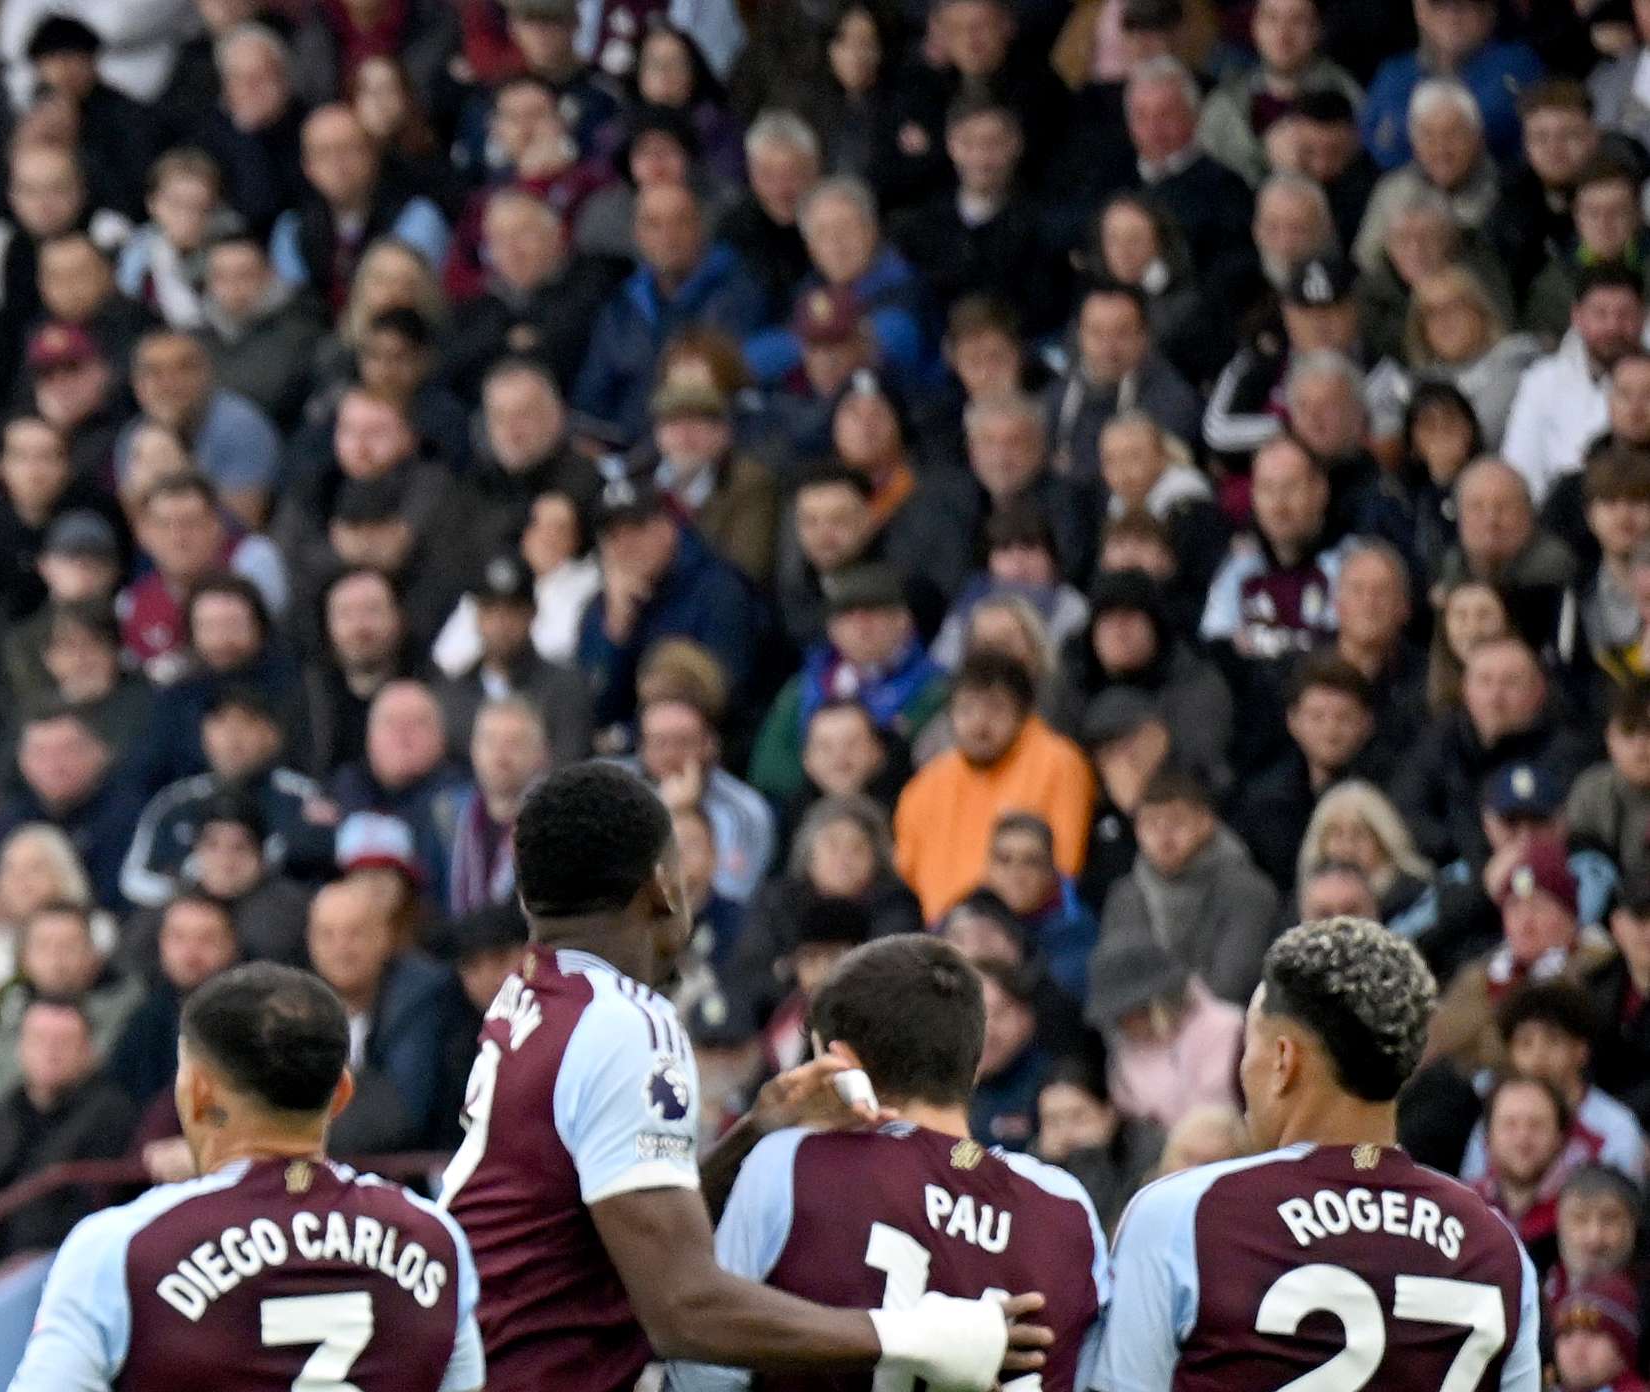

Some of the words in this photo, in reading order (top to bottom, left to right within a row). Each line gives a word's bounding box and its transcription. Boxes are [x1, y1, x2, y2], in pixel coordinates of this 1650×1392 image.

[924, 1183, 1012, 1254] PAU
[1278, 1189, 1465, 1261] ROGERS
[157, 1217, 288, 1322] DIEGO
[292, 1211, 447, 1309] CARLOS
